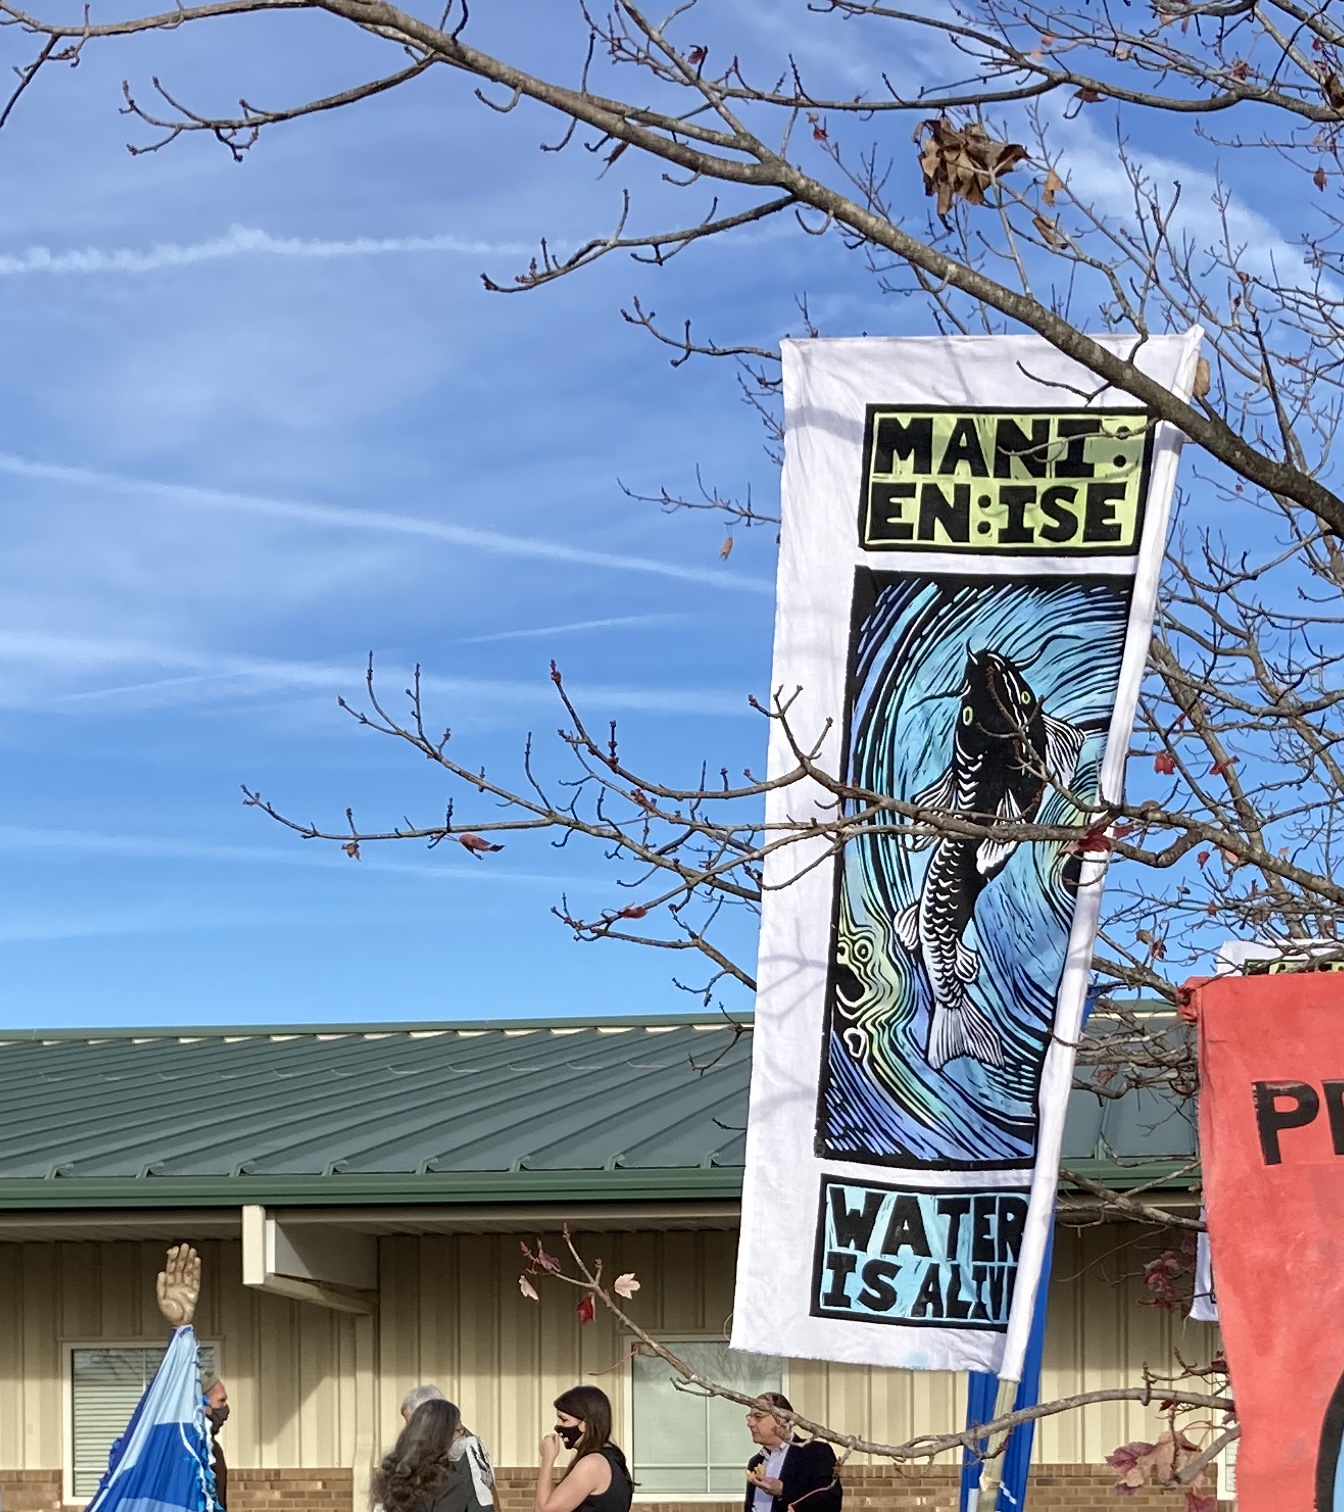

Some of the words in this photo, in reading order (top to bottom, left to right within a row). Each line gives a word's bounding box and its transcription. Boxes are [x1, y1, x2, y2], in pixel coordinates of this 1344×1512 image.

[868, 481, 1127, 544] EN:ISE
[829, 1187, 1028, 1262] WATER
[823, 1252, 901, 1311] IS
